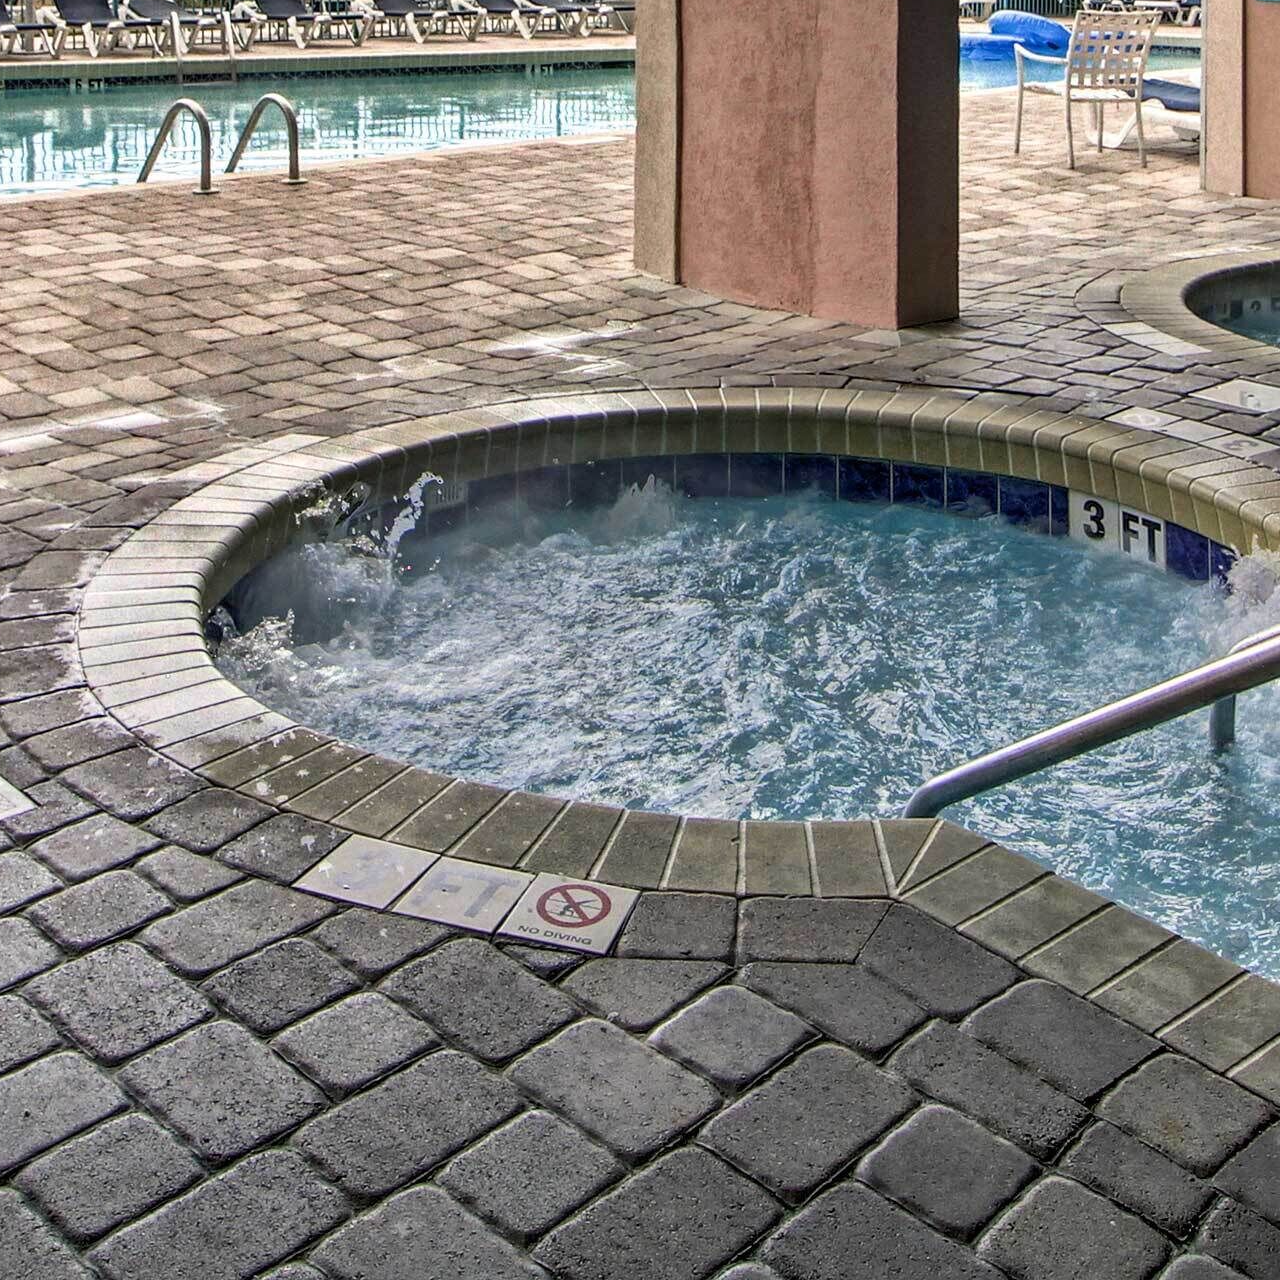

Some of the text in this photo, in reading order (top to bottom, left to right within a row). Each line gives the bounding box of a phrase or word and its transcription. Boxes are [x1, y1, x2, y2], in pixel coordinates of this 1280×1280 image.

[1083, 499, 1161, 563] 3 FT
[411, 870, 522, 918] FT
[518, 925, 593, 945] NO DIVING
